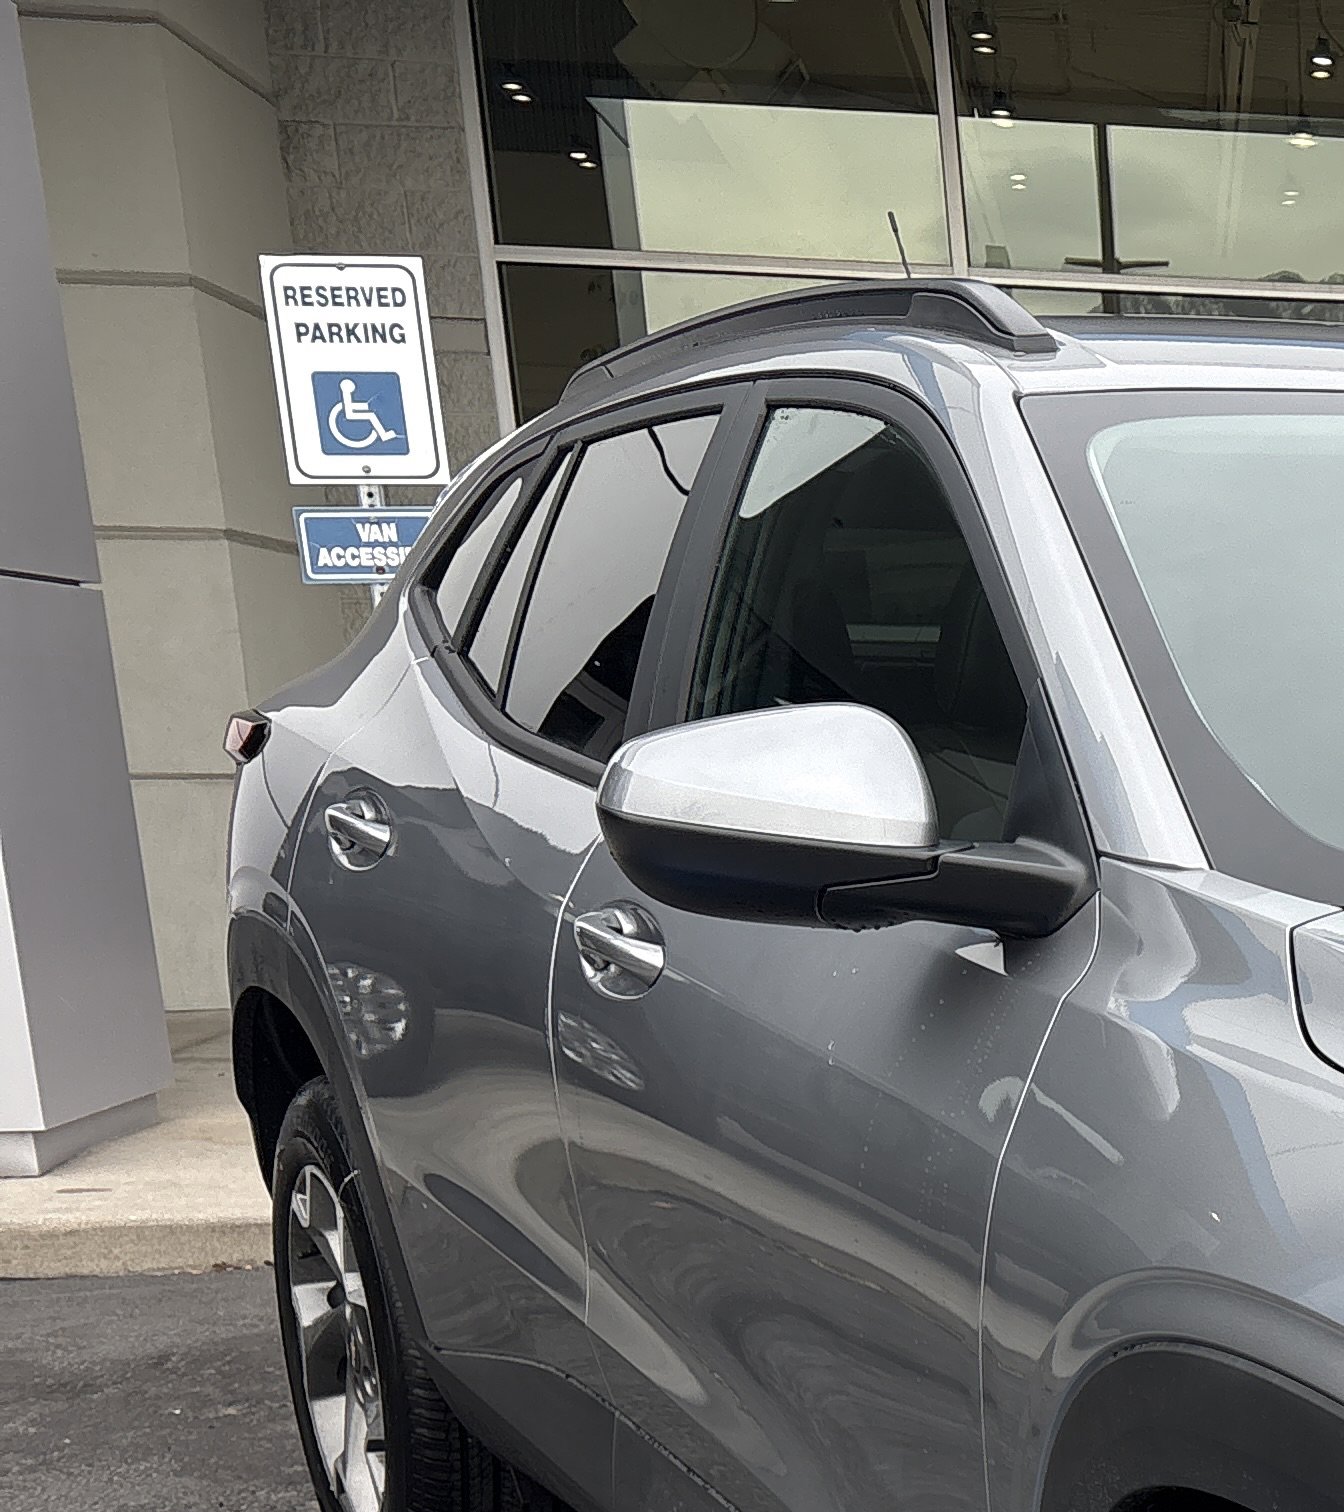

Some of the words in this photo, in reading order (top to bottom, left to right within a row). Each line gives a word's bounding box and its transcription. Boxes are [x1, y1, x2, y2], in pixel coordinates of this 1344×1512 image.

[282, 285, 408, 308] RESERVED
[293, 322, 408, 345] PARKING
[355, 522, 399, 542] VAN
